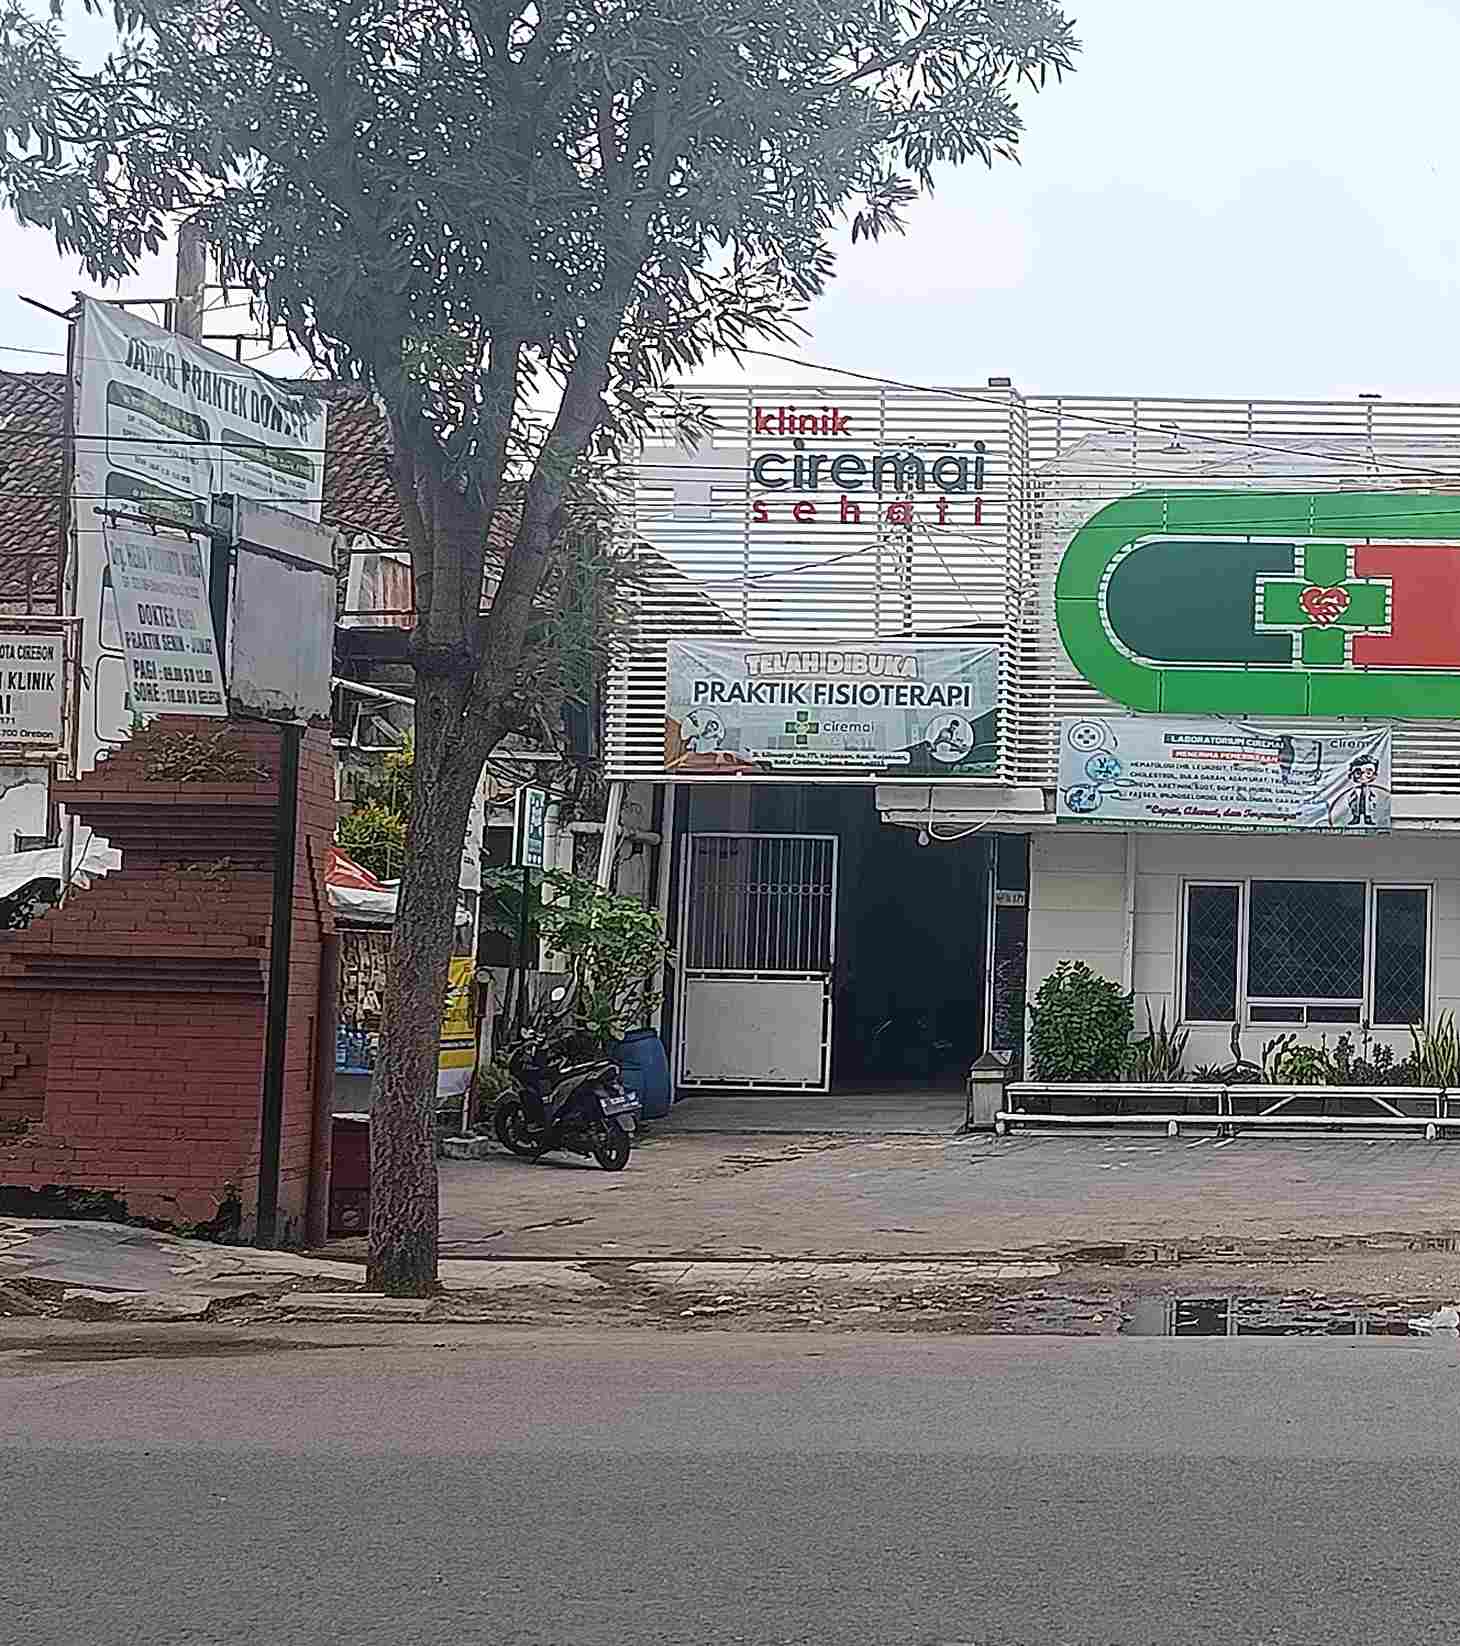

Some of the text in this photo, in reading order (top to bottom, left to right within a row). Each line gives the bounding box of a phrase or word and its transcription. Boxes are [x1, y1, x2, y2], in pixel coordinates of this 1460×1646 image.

[181, 358, 248, 420] PRAKTEK
[755, 405, 852, 435] klinik
[752, 440, 985, 491] ciremai
[752, 495, 984, 526] sehati
[746, 652, 919, 678] TELAH DIBUKA
[8, 671, 55, 691] KLINIK
[692, 681, 971, 708] PRAKTIK FISIOTERAPI
[823, 721, 875, 734] ciremai
[1170, 733, 1245, 746] LABORATORIUM
